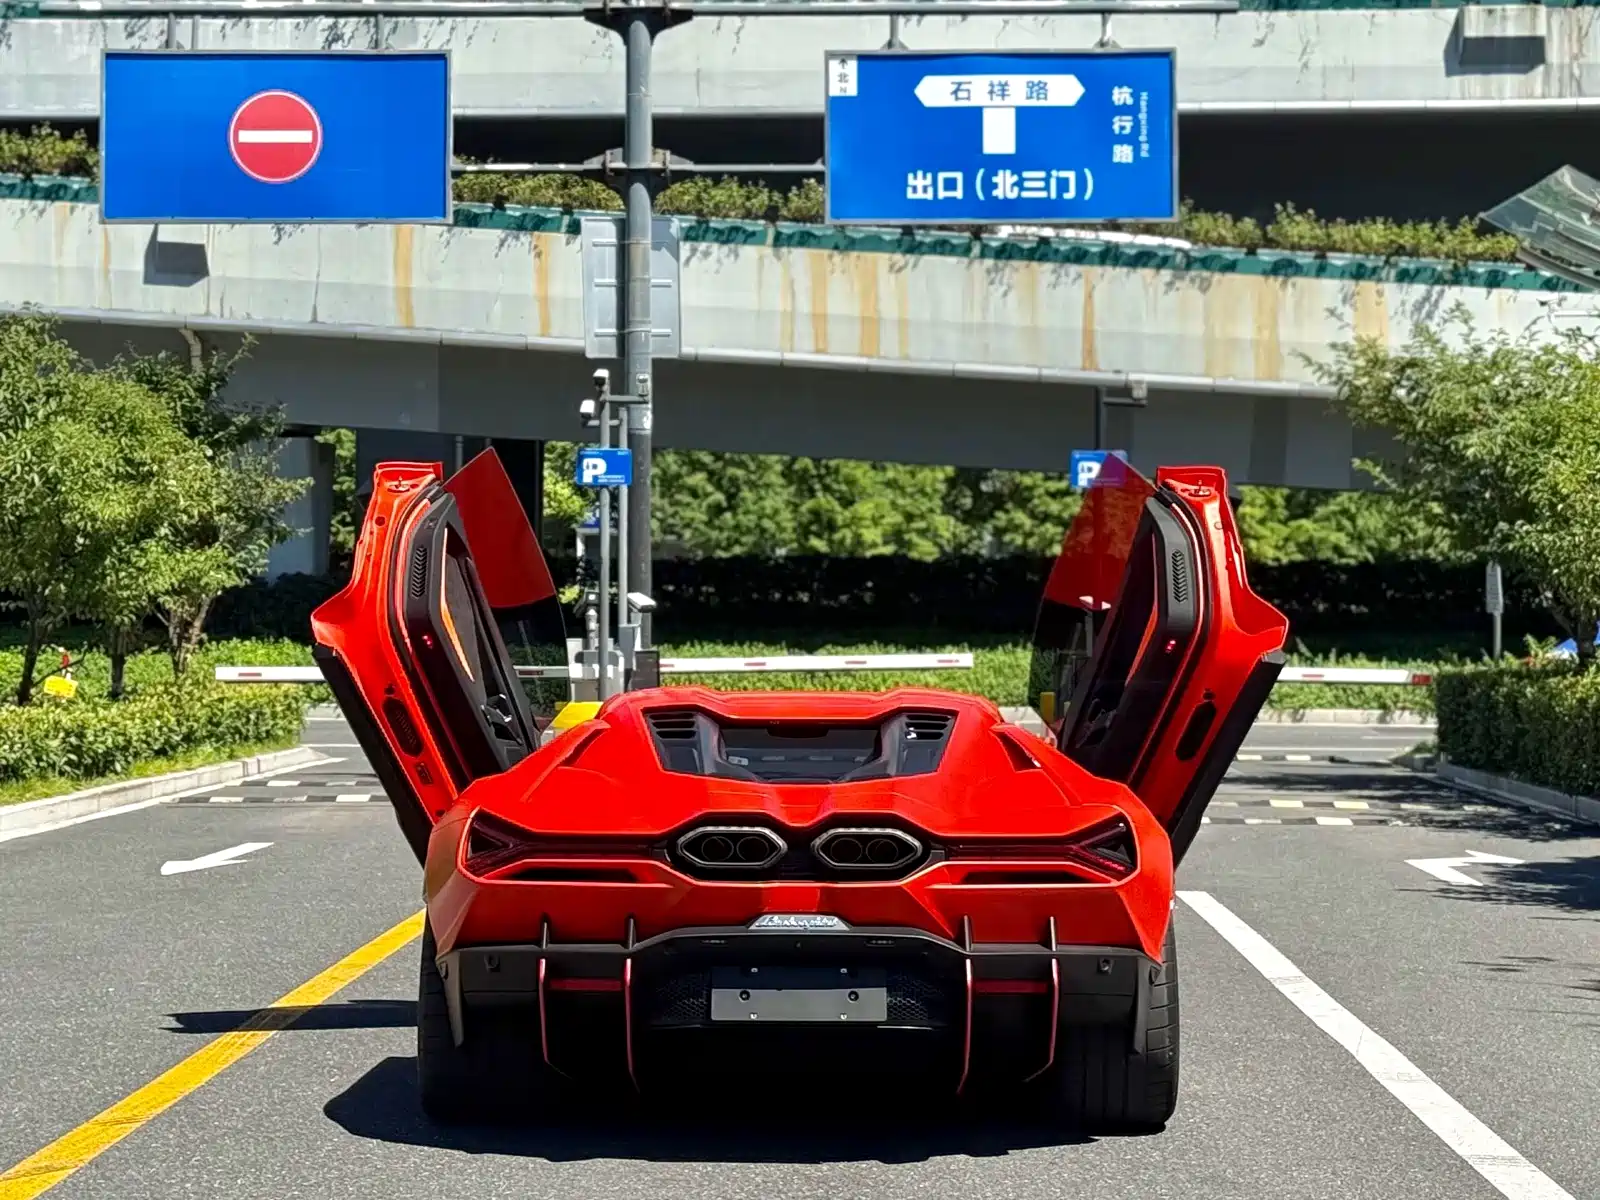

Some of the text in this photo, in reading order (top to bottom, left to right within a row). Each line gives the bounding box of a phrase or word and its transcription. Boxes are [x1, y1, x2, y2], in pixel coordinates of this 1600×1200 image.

[837, 72, 849, 83] 北
[950, 80, 1049, 102] 石祥路
[1112, 85, 1134, 164] 杭行路
[582, 457, 607, 483] P
